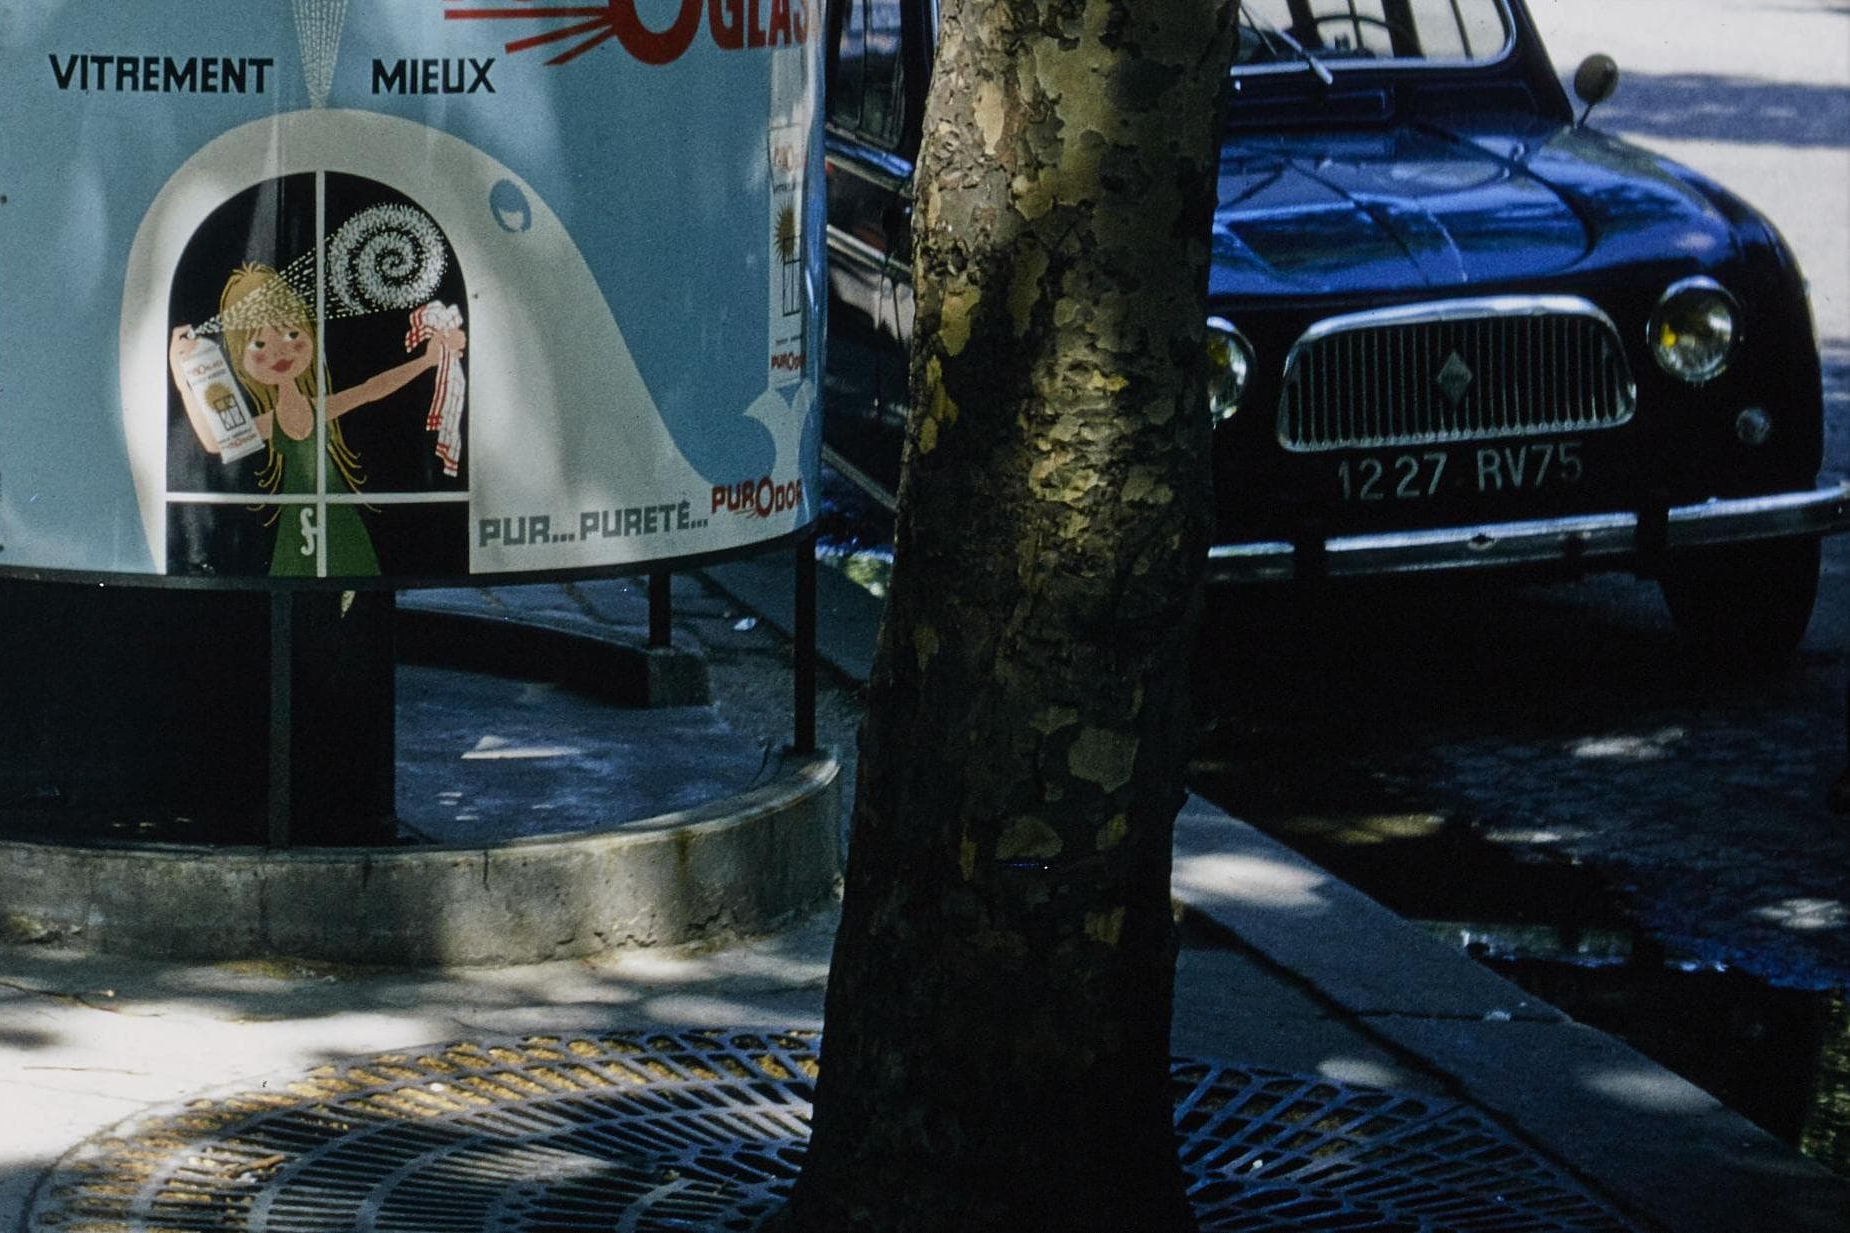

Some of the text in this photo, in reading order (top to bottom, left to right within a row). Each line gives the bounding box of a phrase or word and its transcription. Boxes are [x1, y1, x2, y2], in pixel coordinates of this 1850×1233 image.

[49, 54, 496, 95] VITREMENT MIEUX
[1337, 440, 1584, 501] 1227 RV75
[478, 515, 576, 549] PUR...
